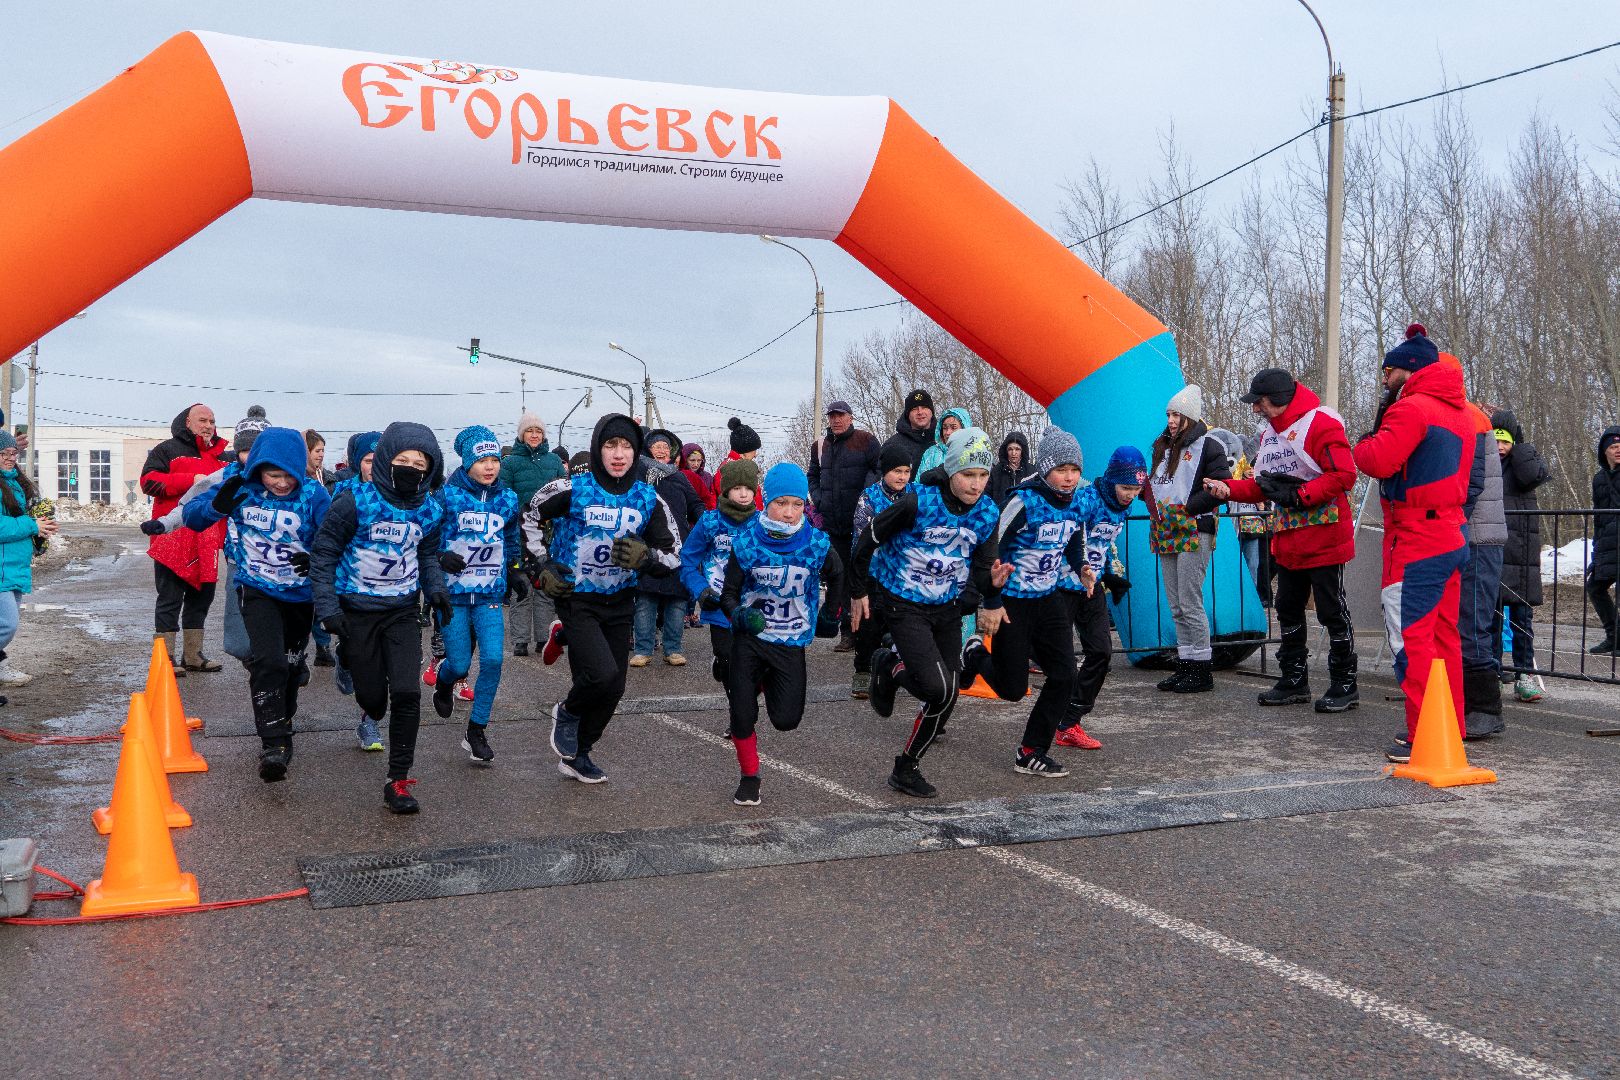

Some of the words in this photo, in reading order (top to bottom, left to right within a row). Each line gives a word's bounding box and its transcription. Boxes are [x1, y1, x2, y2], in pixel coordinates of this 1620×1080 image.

[527, 151, 590, 168] Гордимся
[594, 159, 677, 175] традициями.
[680, 163, 727, 178] Строим
[730, 166, 784, 183] будущее
[1262, 448, 1296, 465] ГЛАВНЫ
[246, 511, 268, 523] bella
[589, 511, 614, 522] bella
[375, 526, 401, 536] bella
[256, 541, 293, 561] 75
[467, 545, 494, 565] 70
[379, 556, 407, 576] 71
[755, 571, 779, 581] bella
[761, 598, 791, 618] 61
